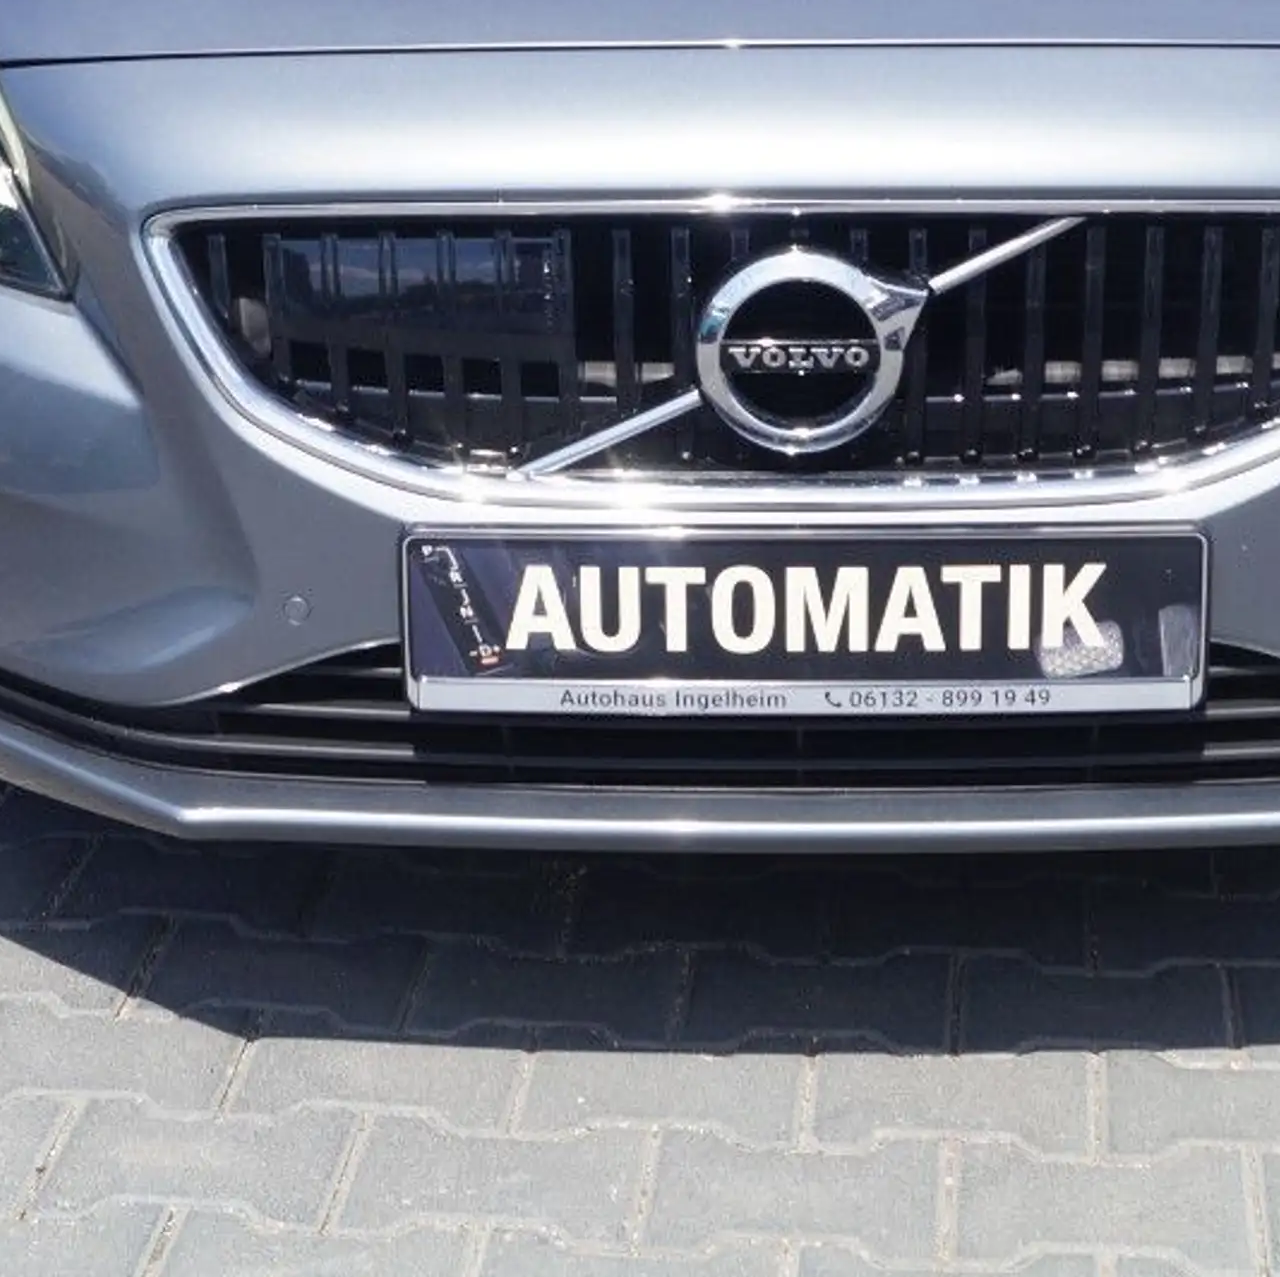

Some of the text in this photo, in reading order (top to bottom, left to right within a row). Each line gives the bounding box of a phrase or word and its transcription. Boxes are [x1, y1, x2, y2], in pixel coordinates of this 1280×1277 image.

[728, 345, 870, 370] VOLVO
[505, 563, 1108, 653] AUTOMATIK
[559, 688, 667, 709] Autohaus
[675, 688, 789, 711] Ingelheim
[848, 689, 919, 709] 06132
[941, 689, 983, 708] 899
[991, 689, 1017, 708] 19
[1024, 689, 1052, 707] 49
